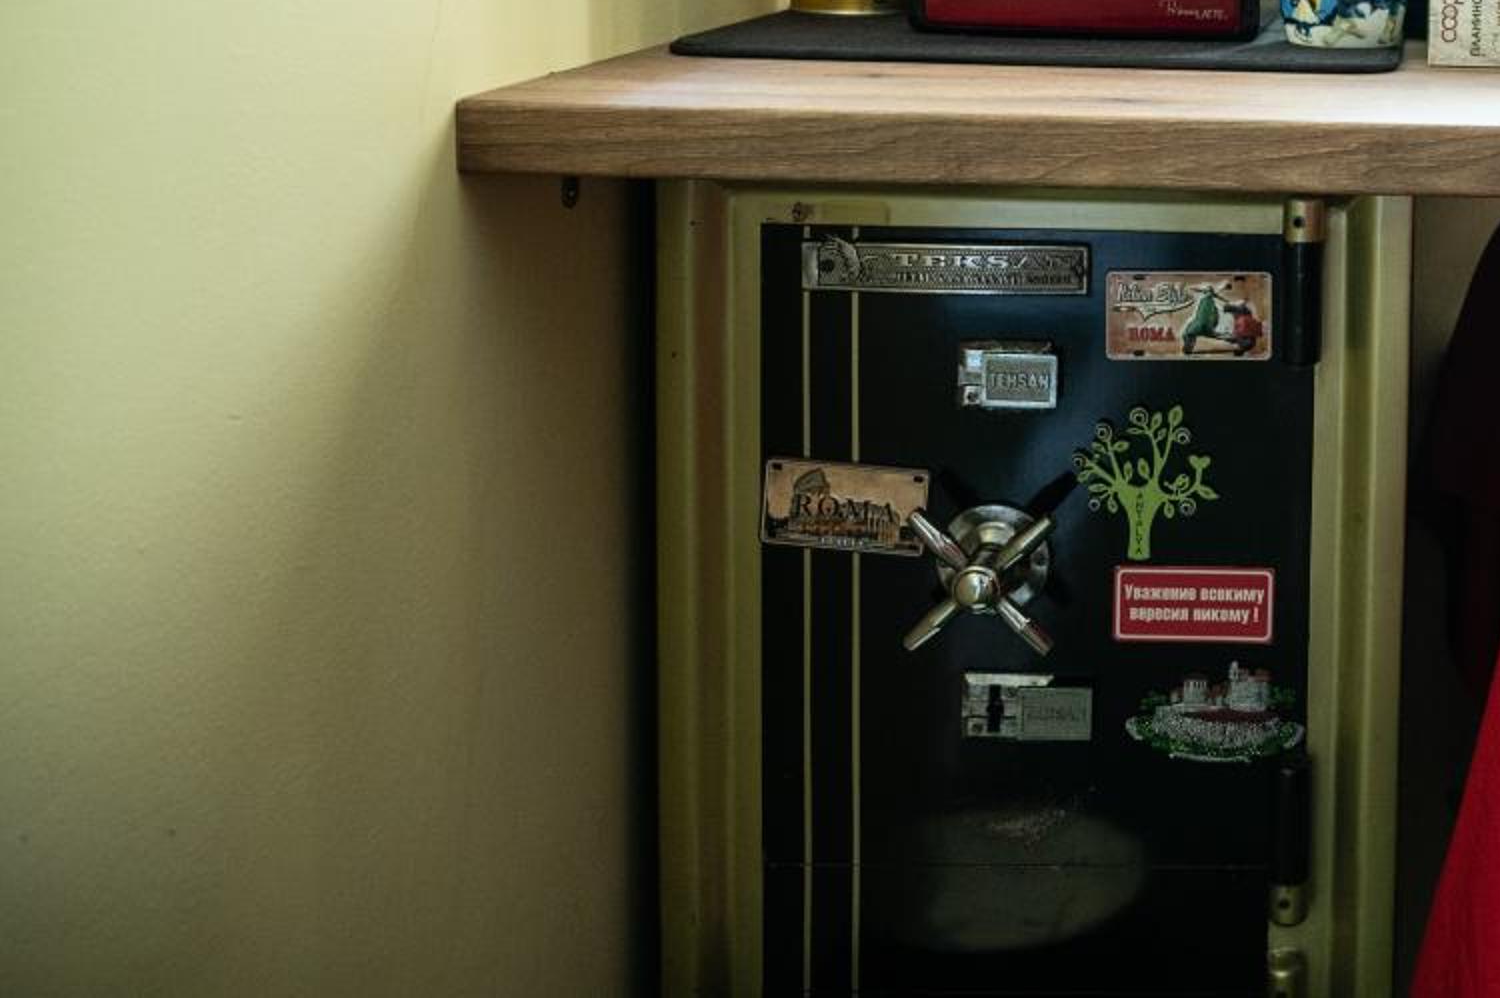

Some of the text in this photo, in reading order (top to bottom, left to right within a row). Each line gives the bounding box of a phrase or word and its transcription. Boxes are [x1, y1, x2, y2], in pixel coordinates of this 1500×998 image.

[1128, 325, 1176, 343] ROMA
[794, 493, 896, 526] ROMA
[1135, 492, 1144, 556] ANTALYA
